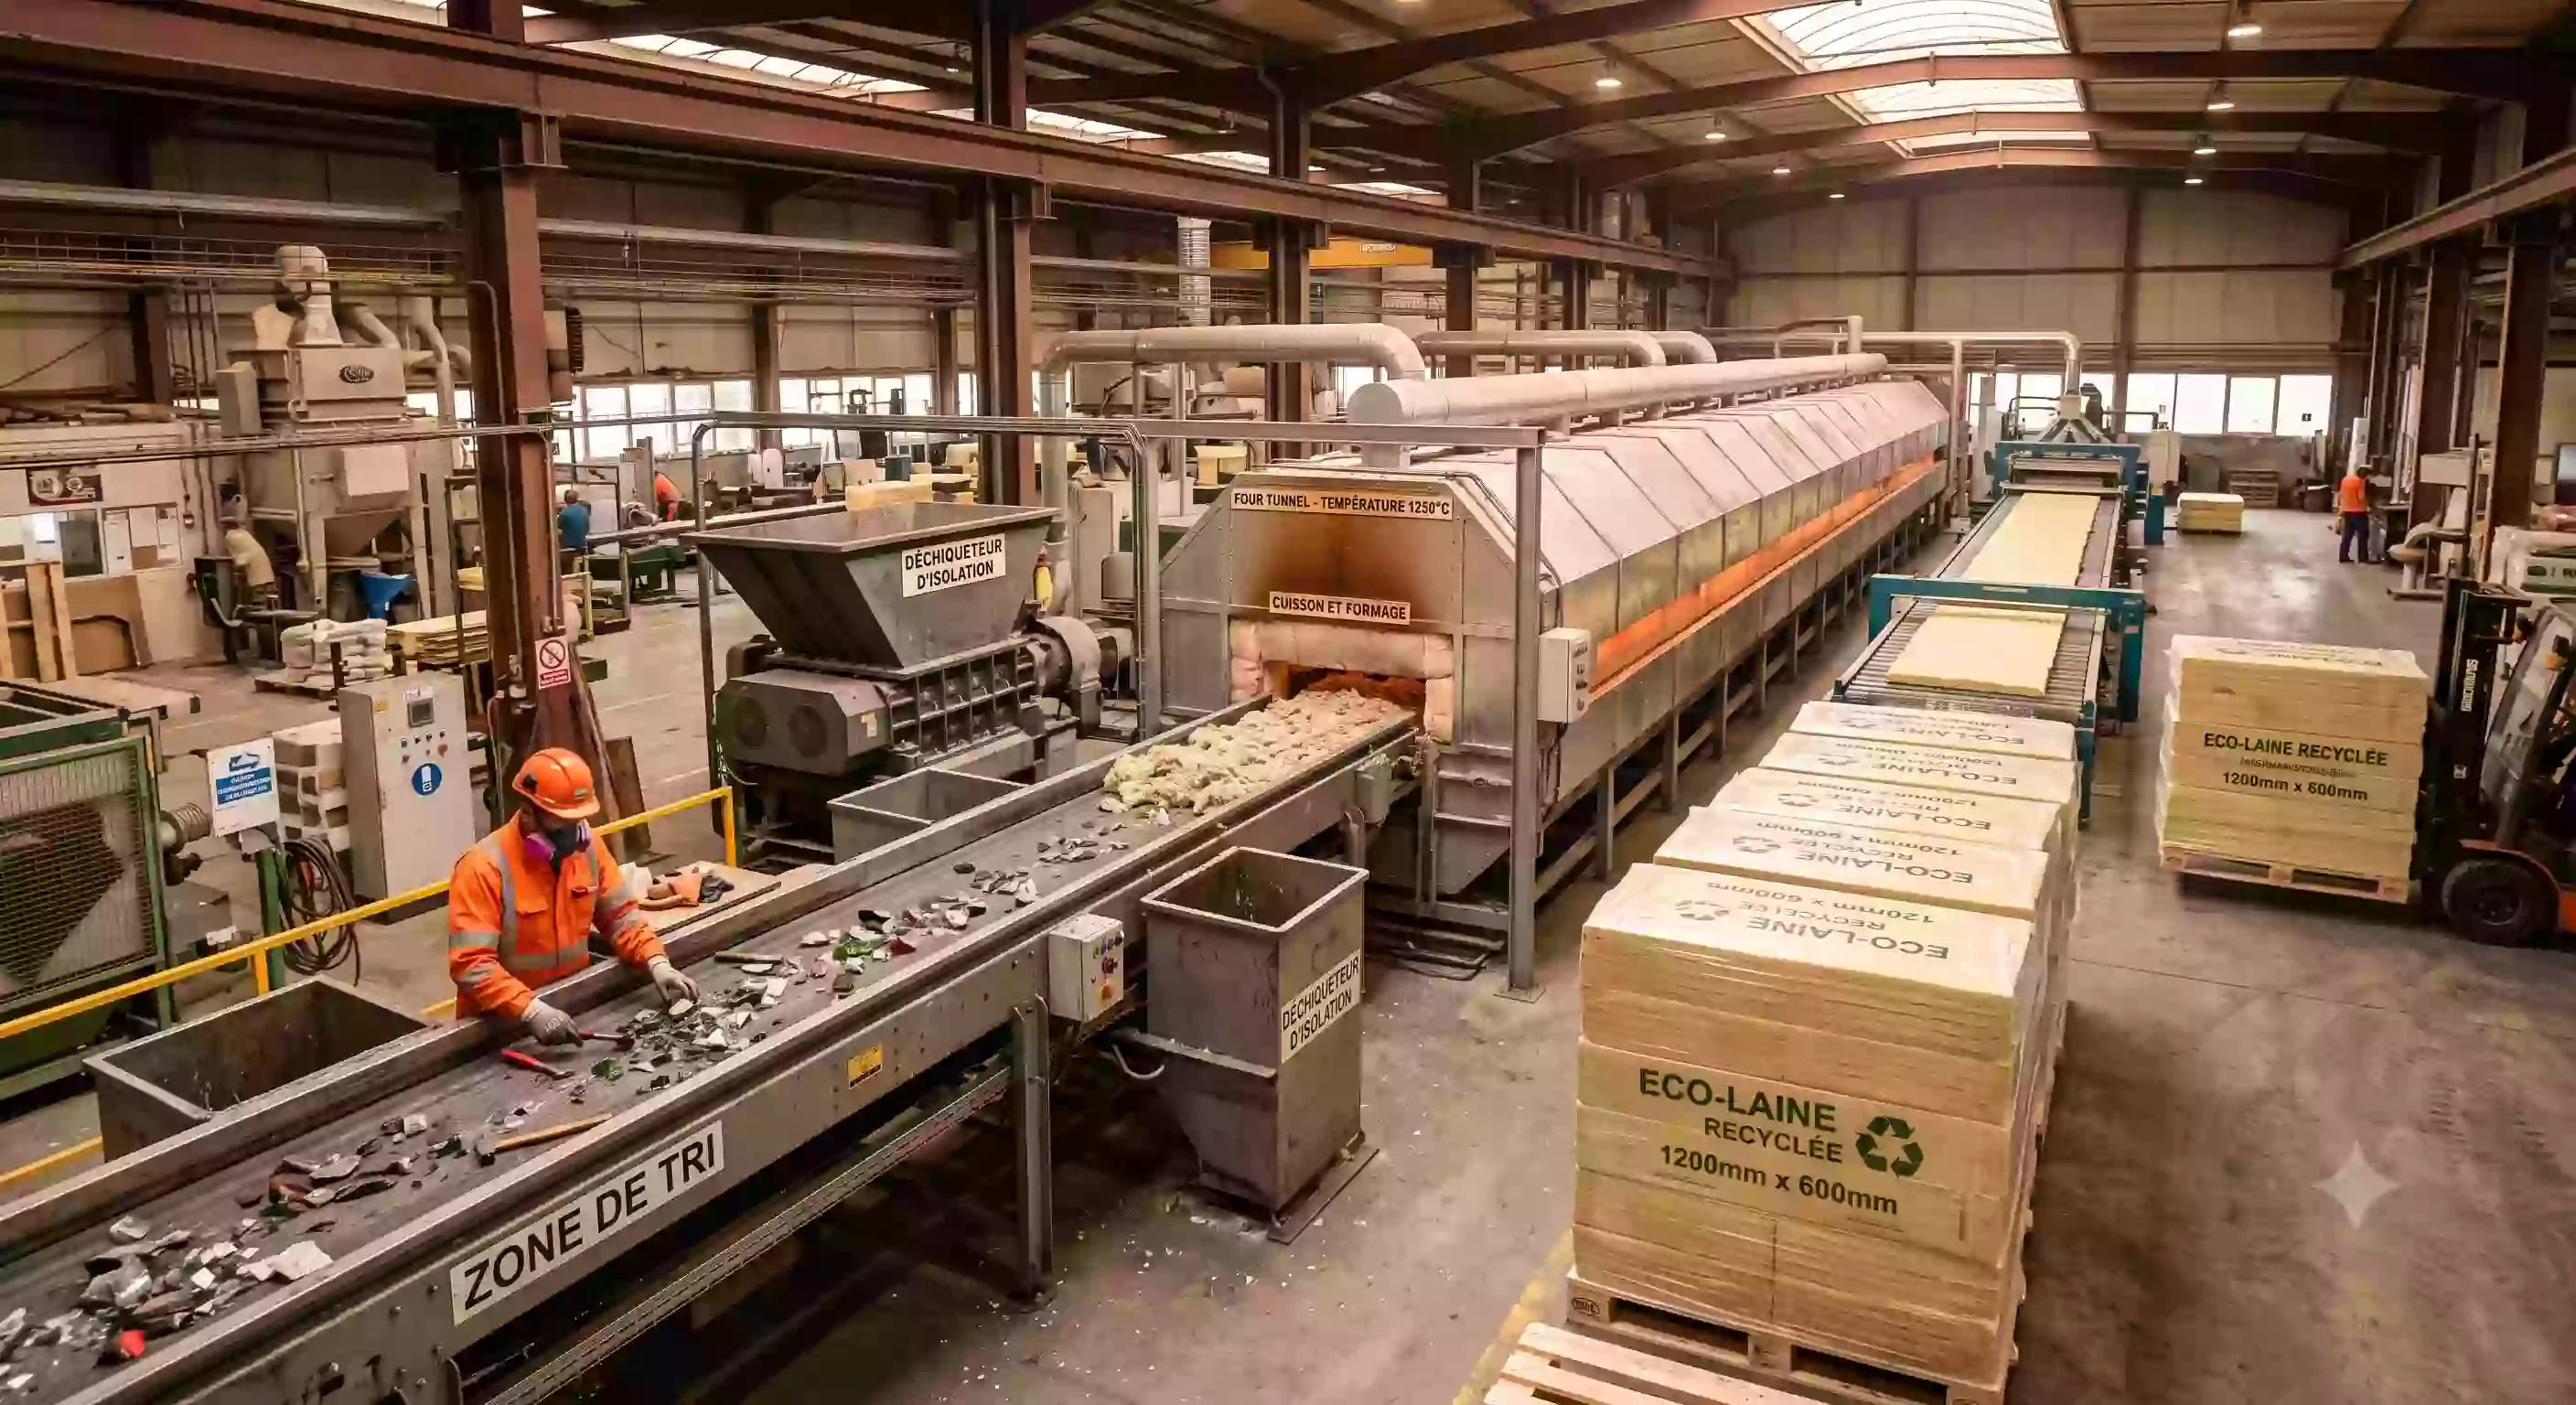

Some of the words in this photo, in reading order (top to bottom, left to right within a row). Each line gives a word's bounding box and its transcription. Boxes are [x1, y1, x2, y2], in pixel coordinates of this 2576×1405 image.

[1235, 492, 1263, 506] FOUR
[1265, 494, 1310, 508] TUNNEL
[1321, 495, 1406, 512] TEMPÉRATURE
[1409, 501, 1449, 515] 1250°C
[905, 539, 1003, 570] DÉCHIQUETEUR
[917, 560, 993, 589] D'ISOLATION
[1272, 595, 1325, 612] CUISSON
[1327, 601, 1342, 614] ET
[1347, 602, 1407, 619] FORMAGE
[2204, 733, 2293, 756] ECO-LAINE
[2297, 742, 2389, 767] RECYCLÉE
[2223, 771, 2289, 791] 1200mm
[2293, 782, 2302, 793] x
[1832, 804, 1991, 830] ECO-LAINE
[1796, 849, 1973, 884] ECO-LAINE
[1746, 916, 1948, 960] ECO-LAINE
[1283, 957, 1359, 1032] DÉCHIQUETEUR
[1290, 988, 1352, 1050] D'ISOLATION
[1639, 1067, 1838, 1133] ECO-LAINE
[1704, 1116, 1842, 1164] RECYCLÉE
[1660, 1144, 1766, 1187] 1200mm
[1775, 1173, 1790, 1192] x
[1798, 1174, 1898, 1215] 600mm
[464, 1207, 584, 1311] ZONE
[596, 1170, 649, 1233] DE
[658, 1132, 715, 1193] TRI
